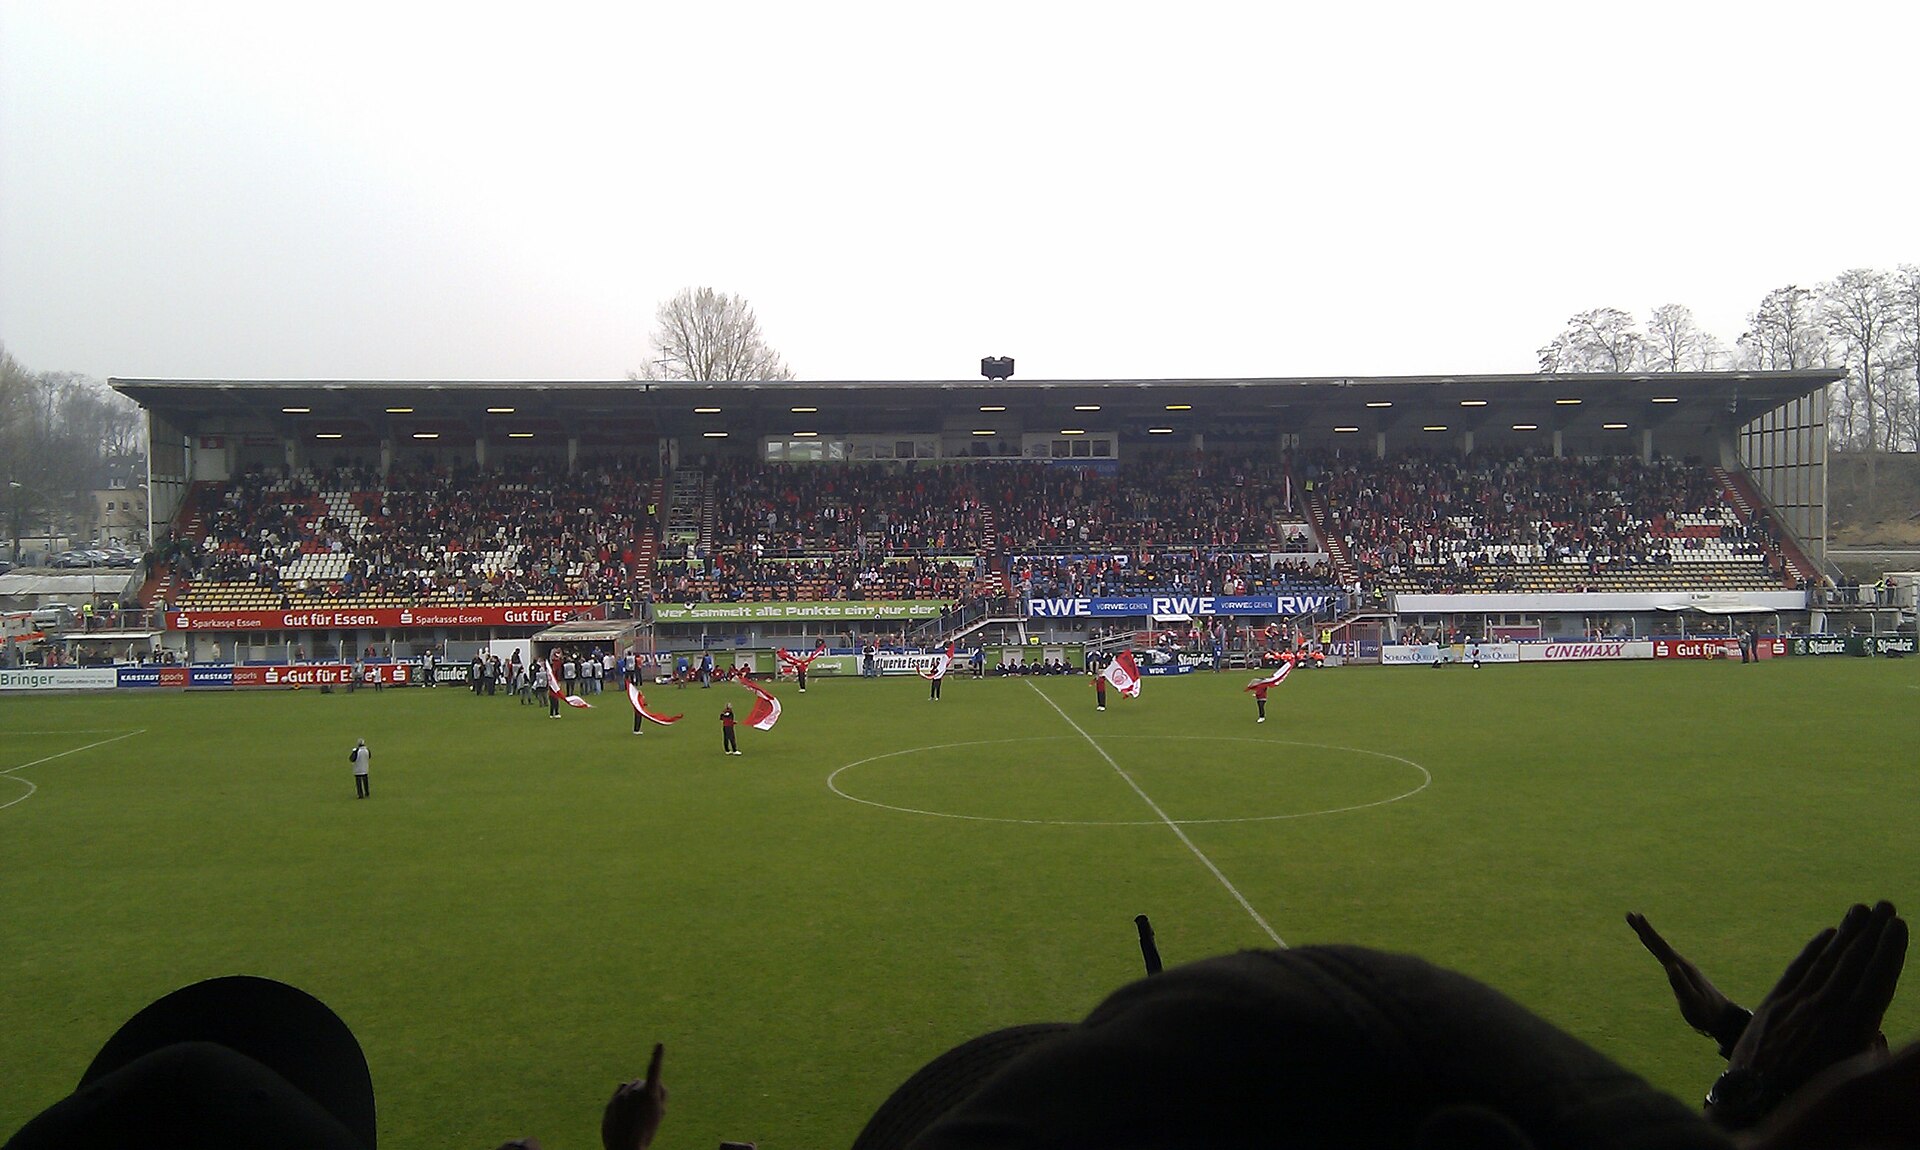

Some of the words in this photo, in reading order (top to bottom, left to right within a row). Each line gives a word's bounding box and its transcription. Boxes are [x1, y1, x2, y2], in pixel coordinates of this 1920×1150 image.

[690, 607, 752, 618] sammelt
[756, 606, 782, 617] alle
[786, 606, 841, 616] Punkte
[845, 605, 875, 616] ein?
[879, 606, 906, 615] Nur
[909, 605, 936, 615] der
[1029, 598, 1092, 616] RWE
[1152, 597, 1216, 615] RWE
[283, 613, 308, 627] Gut
[311, 613, 331, 626] für
[334, 613, 379, 626] Essen.
[415, 614, 458, 625] Sparkasse
[459, 614, 483, 624] Essen
[504, 610, 529, 623] Gut
[531, 609, 551, 622] für
[553, 609, 597, 622] Esn.
[192, 619, 236, 629] Sparkasse
[236, 618, 262, 627] Essen
[1544, 643, 1625, 659] CINEMAXX
[1676, 643, 1700, 656] Gut
[908, 656, 929, 670] Essen
[0, 673, 55, 687] Bringer
[160, 673, 184, 682] sports
[194, 673, 232, 681] KARSTADT
[233, 672, 257, 681] sports
[288, 669, 314, 683] Gut
[316, 668, 337, 682] für
[341, 668, 386, 682] Ese.
